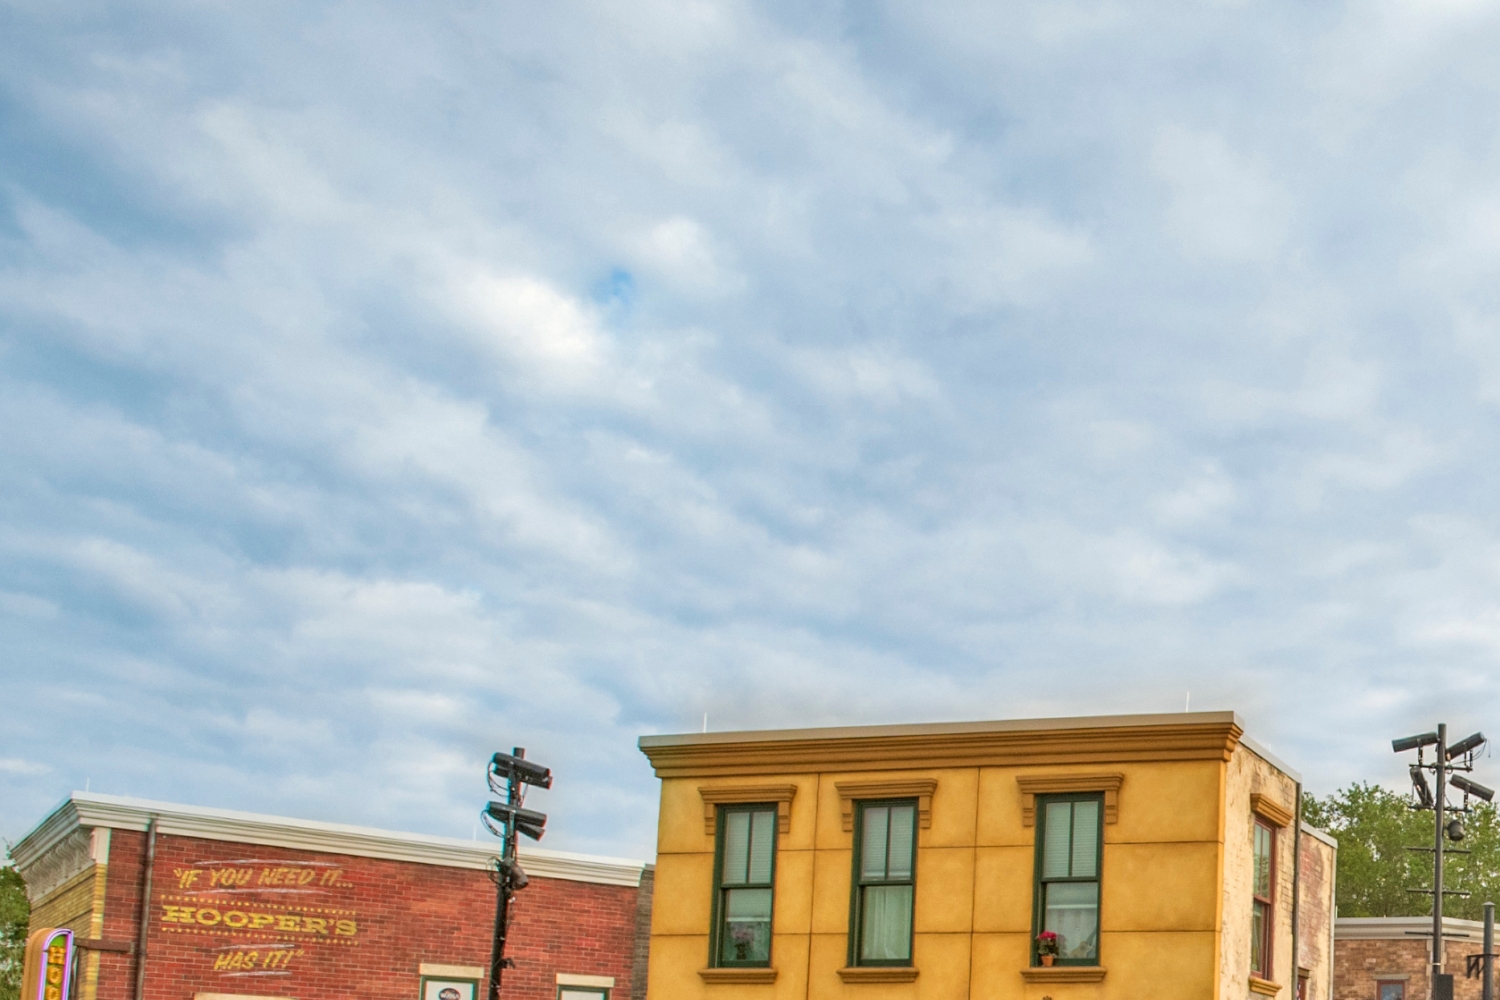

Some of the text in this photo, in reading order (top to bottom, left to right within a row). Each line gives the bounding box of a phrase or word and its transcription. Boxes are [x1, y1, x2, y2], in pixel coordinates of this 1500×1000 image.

[210, 868, 253, 887] YOU
[257, 868, 315, 886] NEED
[319, 869, 353, 888] IT...
[160, 905, 357, 936] HOOPER'S
[213, 951, 259, 971] HAS
